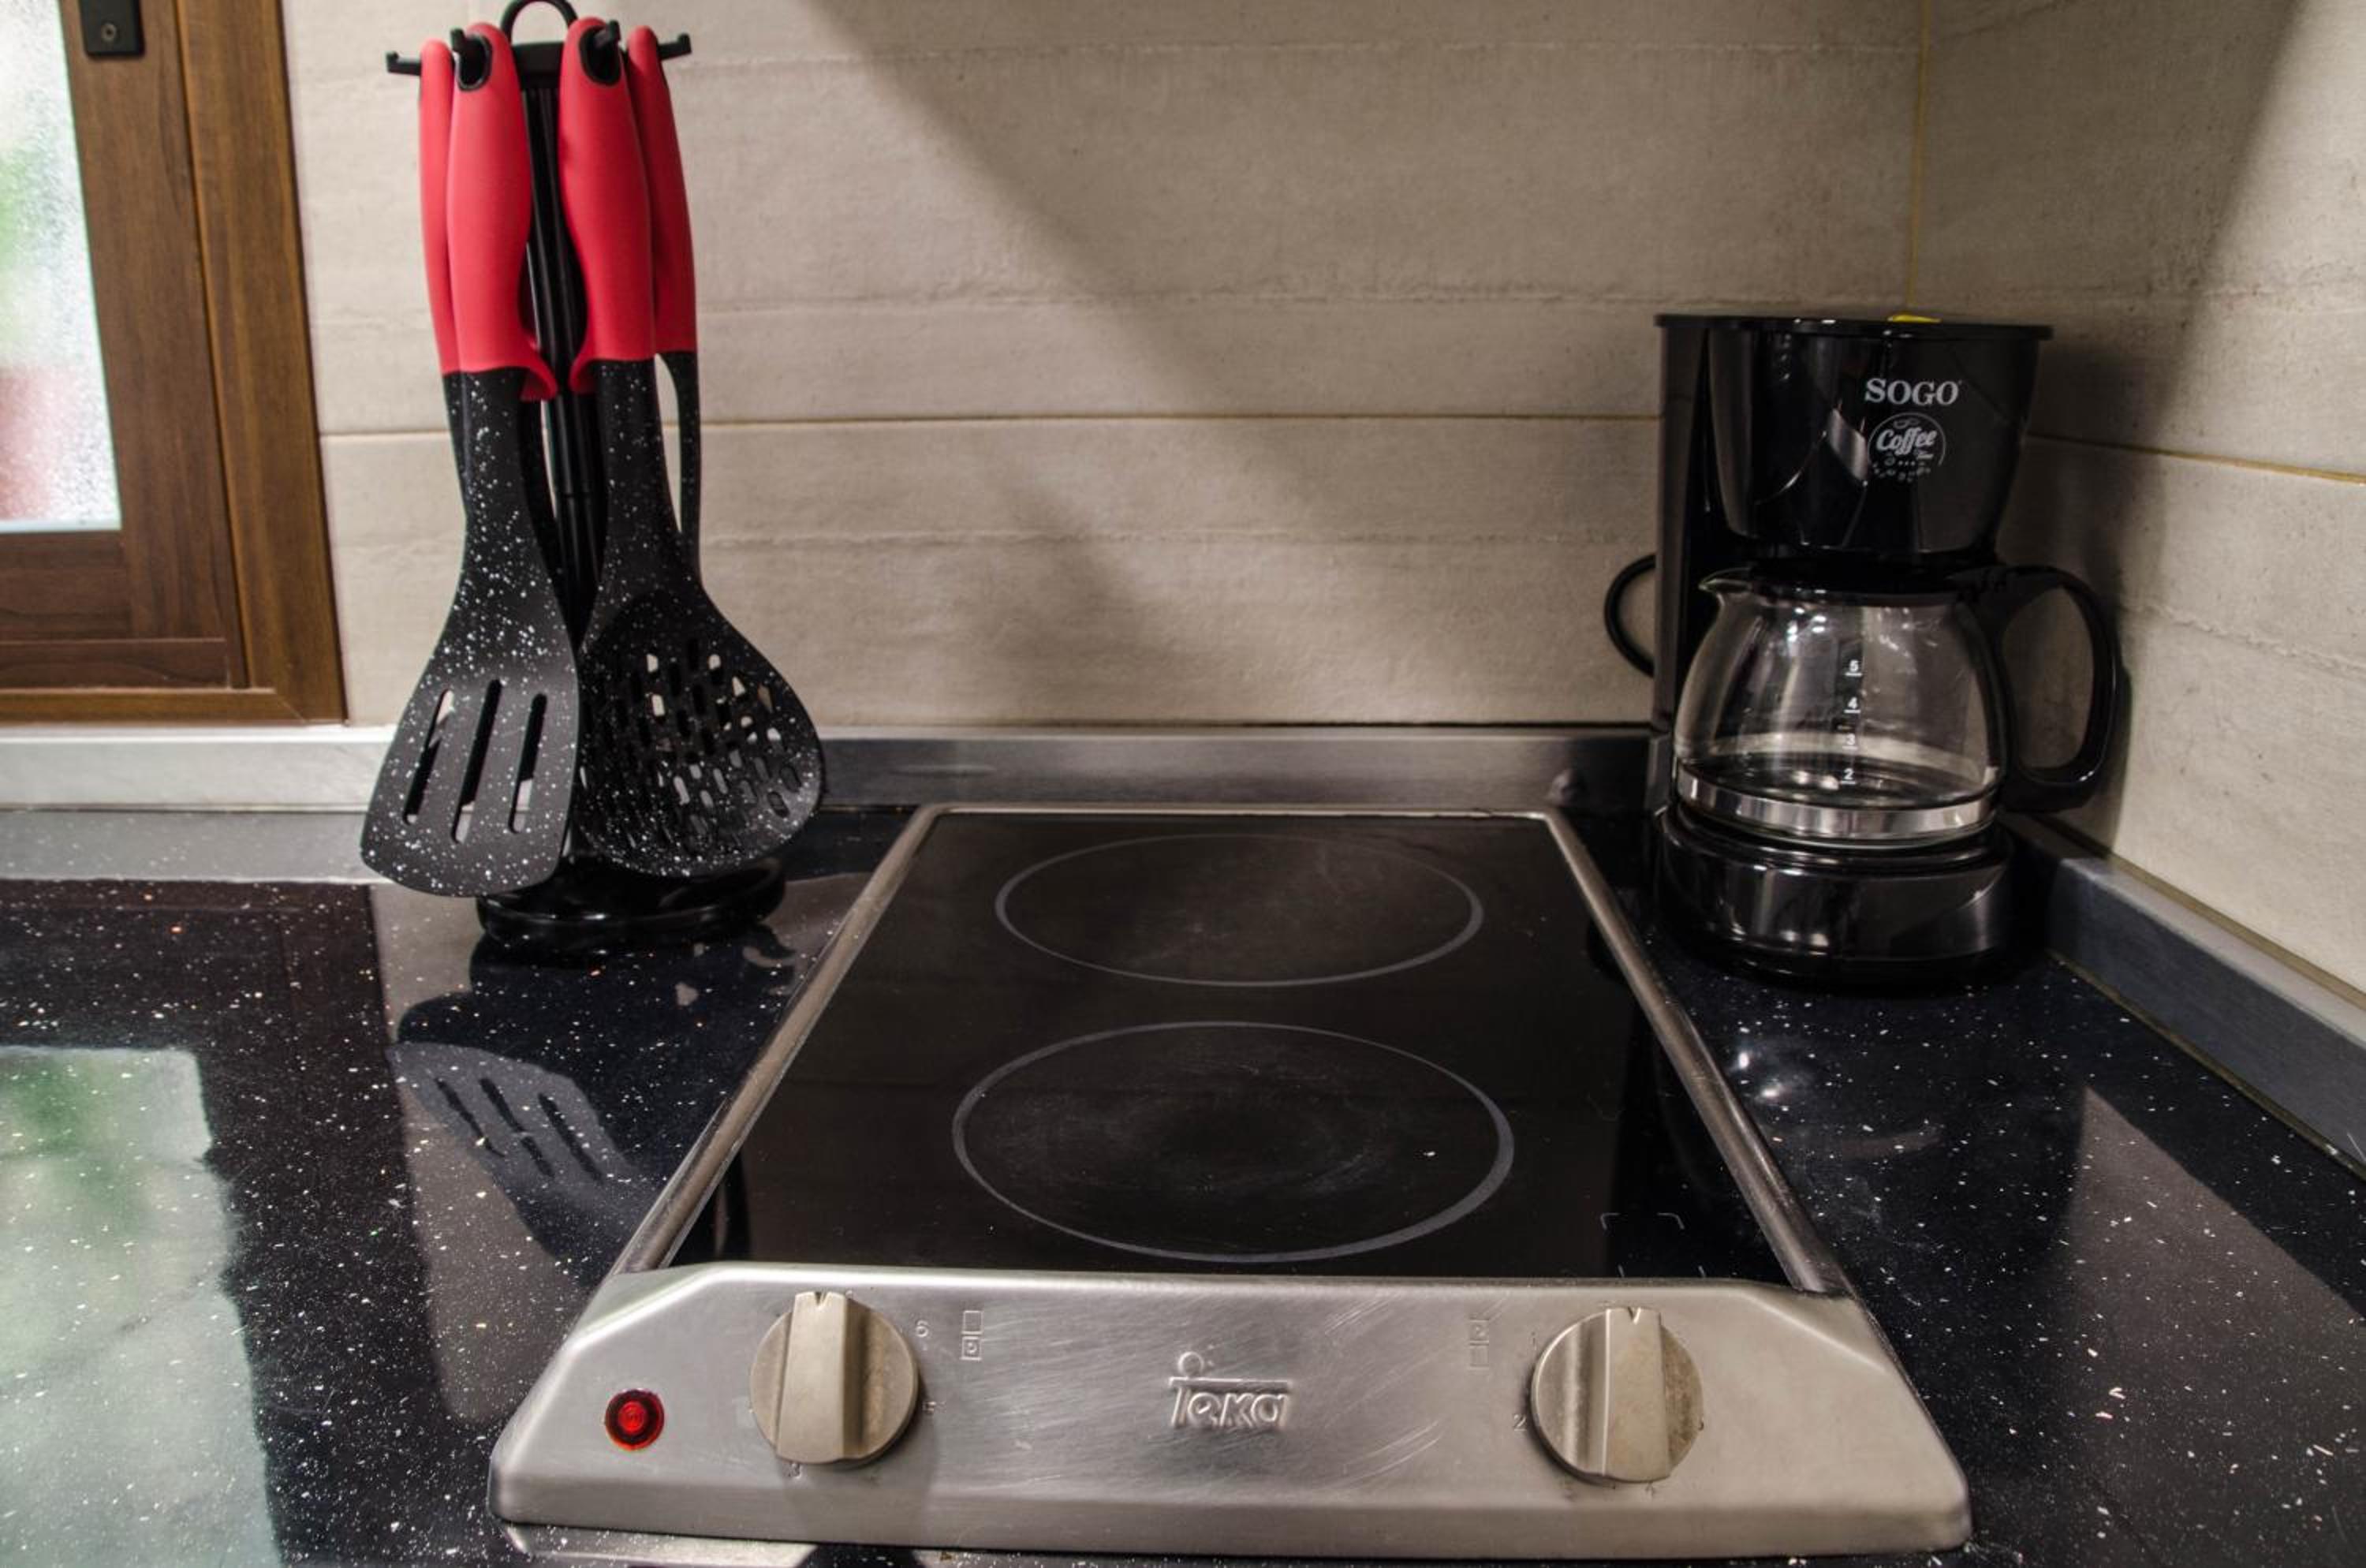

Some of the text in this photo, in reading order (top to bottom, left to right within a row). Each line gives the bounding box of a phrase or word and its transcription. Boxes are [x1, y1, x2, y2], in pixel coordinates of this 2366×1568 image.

[1864, 378, 1958, 405] SOGO
[1876, 427, 1937, 455] Coffee
[1849, 659, 1859, 672] 5
[1848, 696, 1857, 709] 4
[1846, 733, 1855, 745] 3
[1844, 767, 1853, 780] 2
[916, 1320, 928, 1338] 6
[1513, 1414, 1527, 1432] 2
